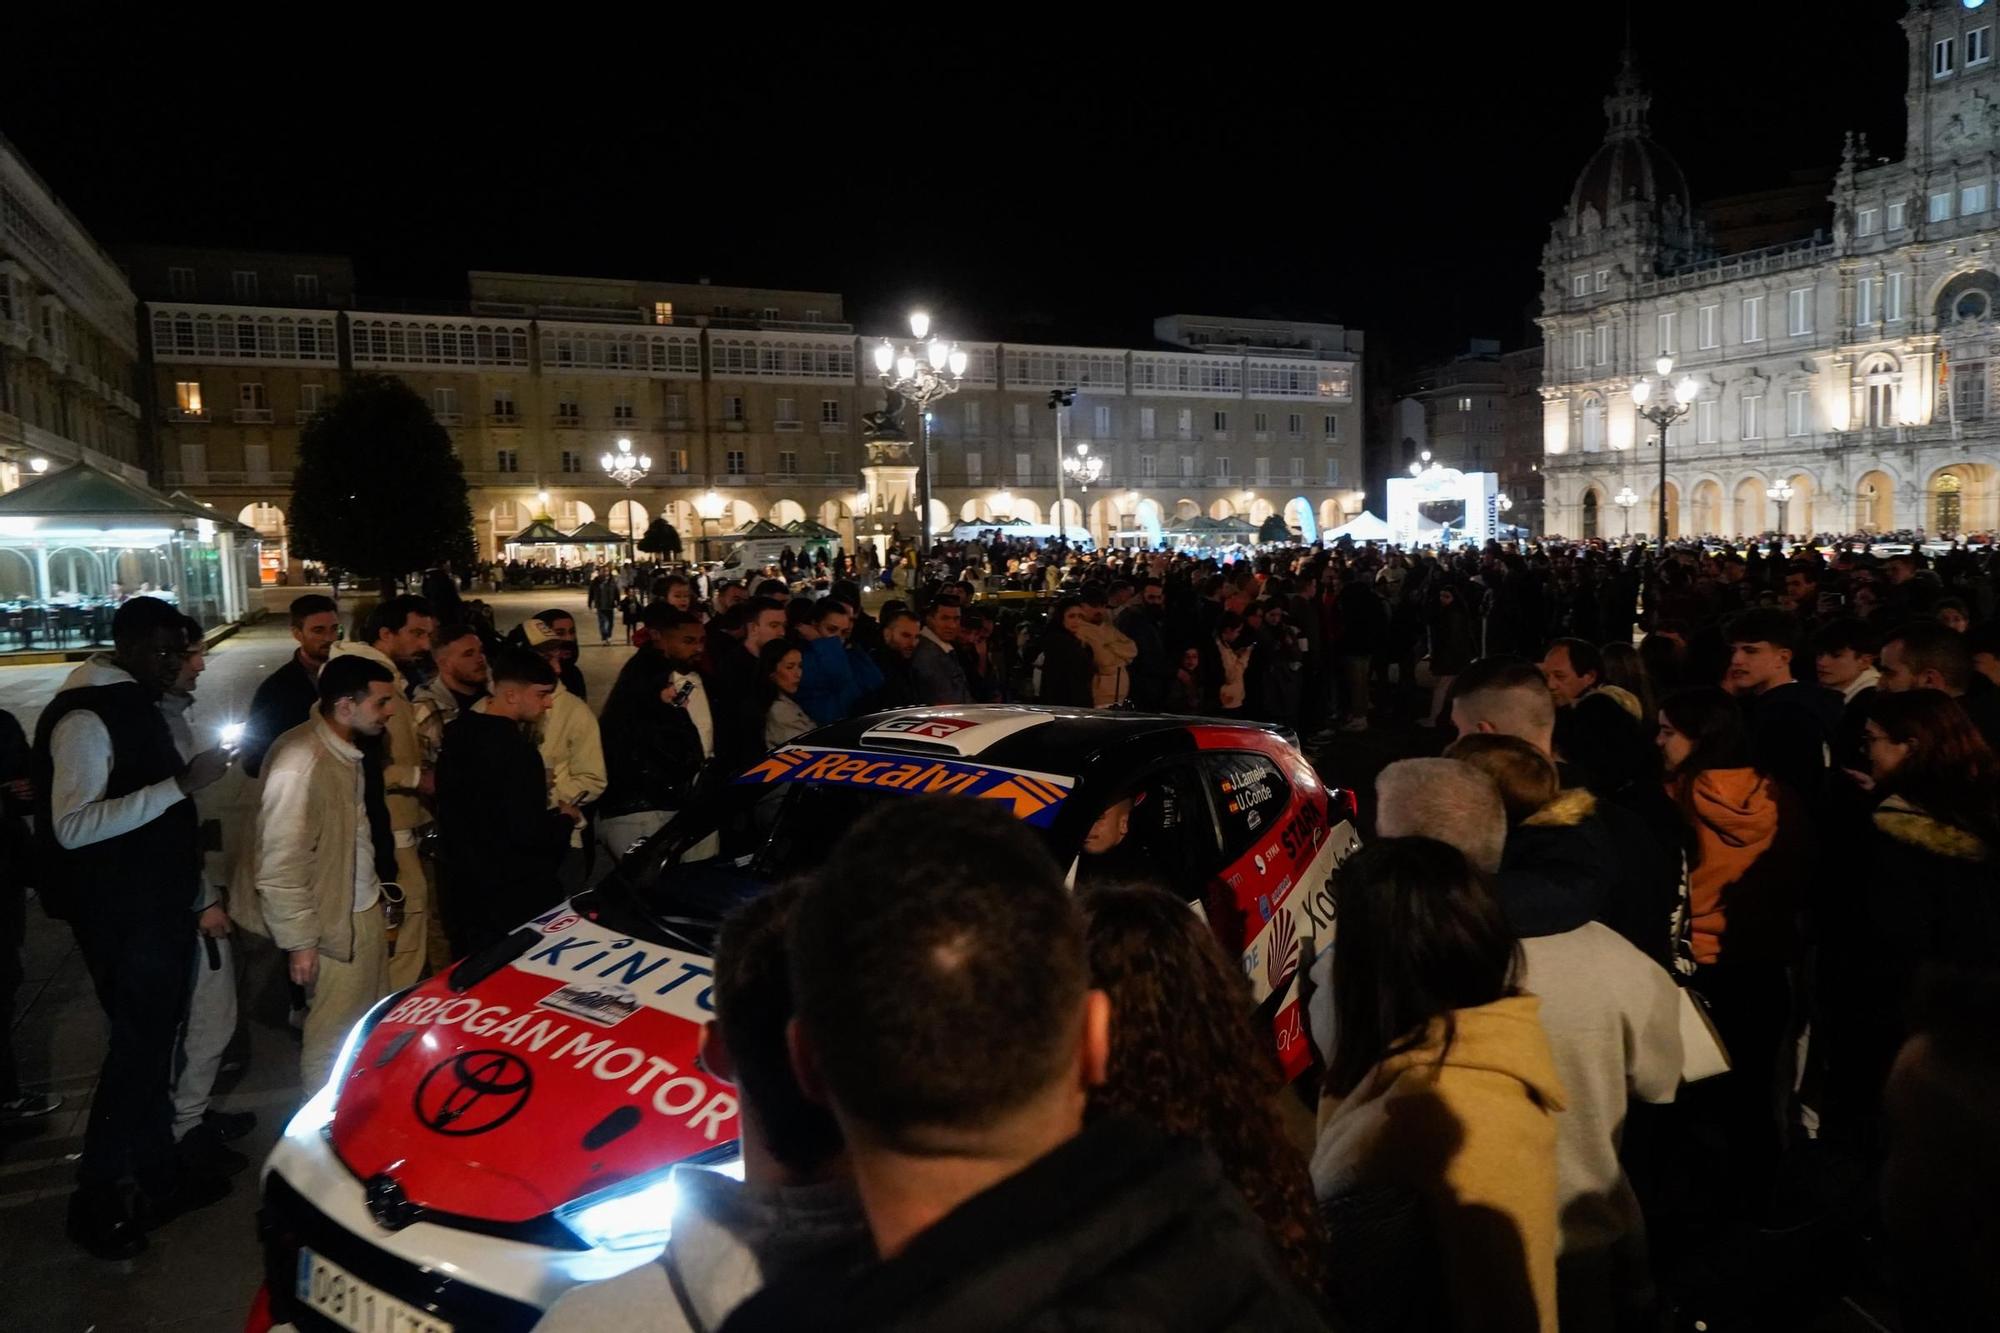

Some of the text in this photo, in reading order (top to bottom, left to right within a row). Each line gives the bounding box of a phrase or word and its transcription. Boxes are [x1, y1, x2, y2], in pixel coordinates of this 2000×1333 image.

[873, 719, 960, 738] GR
[795, 753, 989, 794] Recalvi
[1236, 784, 1273, 811] U.Conde
[380, 996, 571, 1052] BREOGÁN
[549, 1032, 739, 1141] MOTOR
